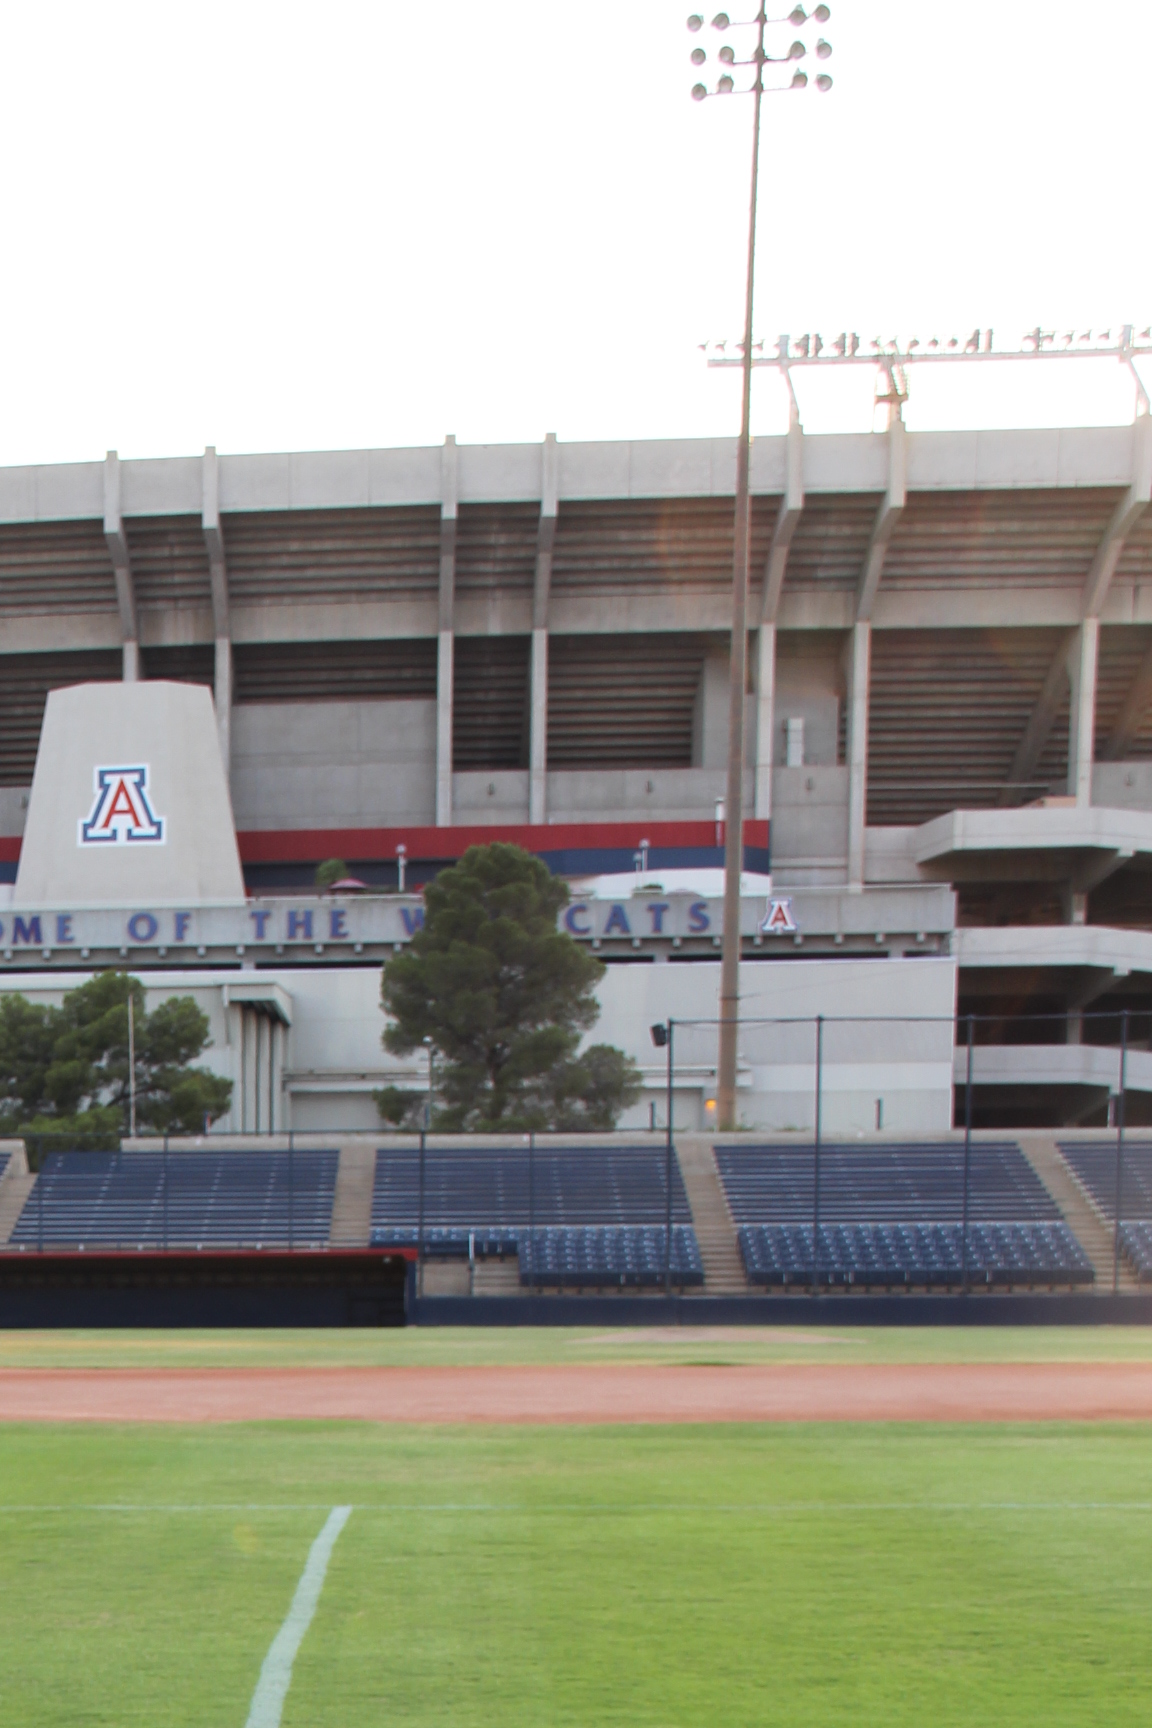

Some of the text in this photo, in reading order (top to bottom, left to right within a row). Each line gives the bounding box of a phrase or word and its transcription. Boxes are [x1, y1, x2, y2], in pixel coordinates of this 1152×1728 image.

[79, 766, 165, 845] A
[128, 912, 191, 942] OF
[251, 909, 349, 940] THE
[400, 901, 710, 939] WCATS
[759, 897, 800, 934] A
